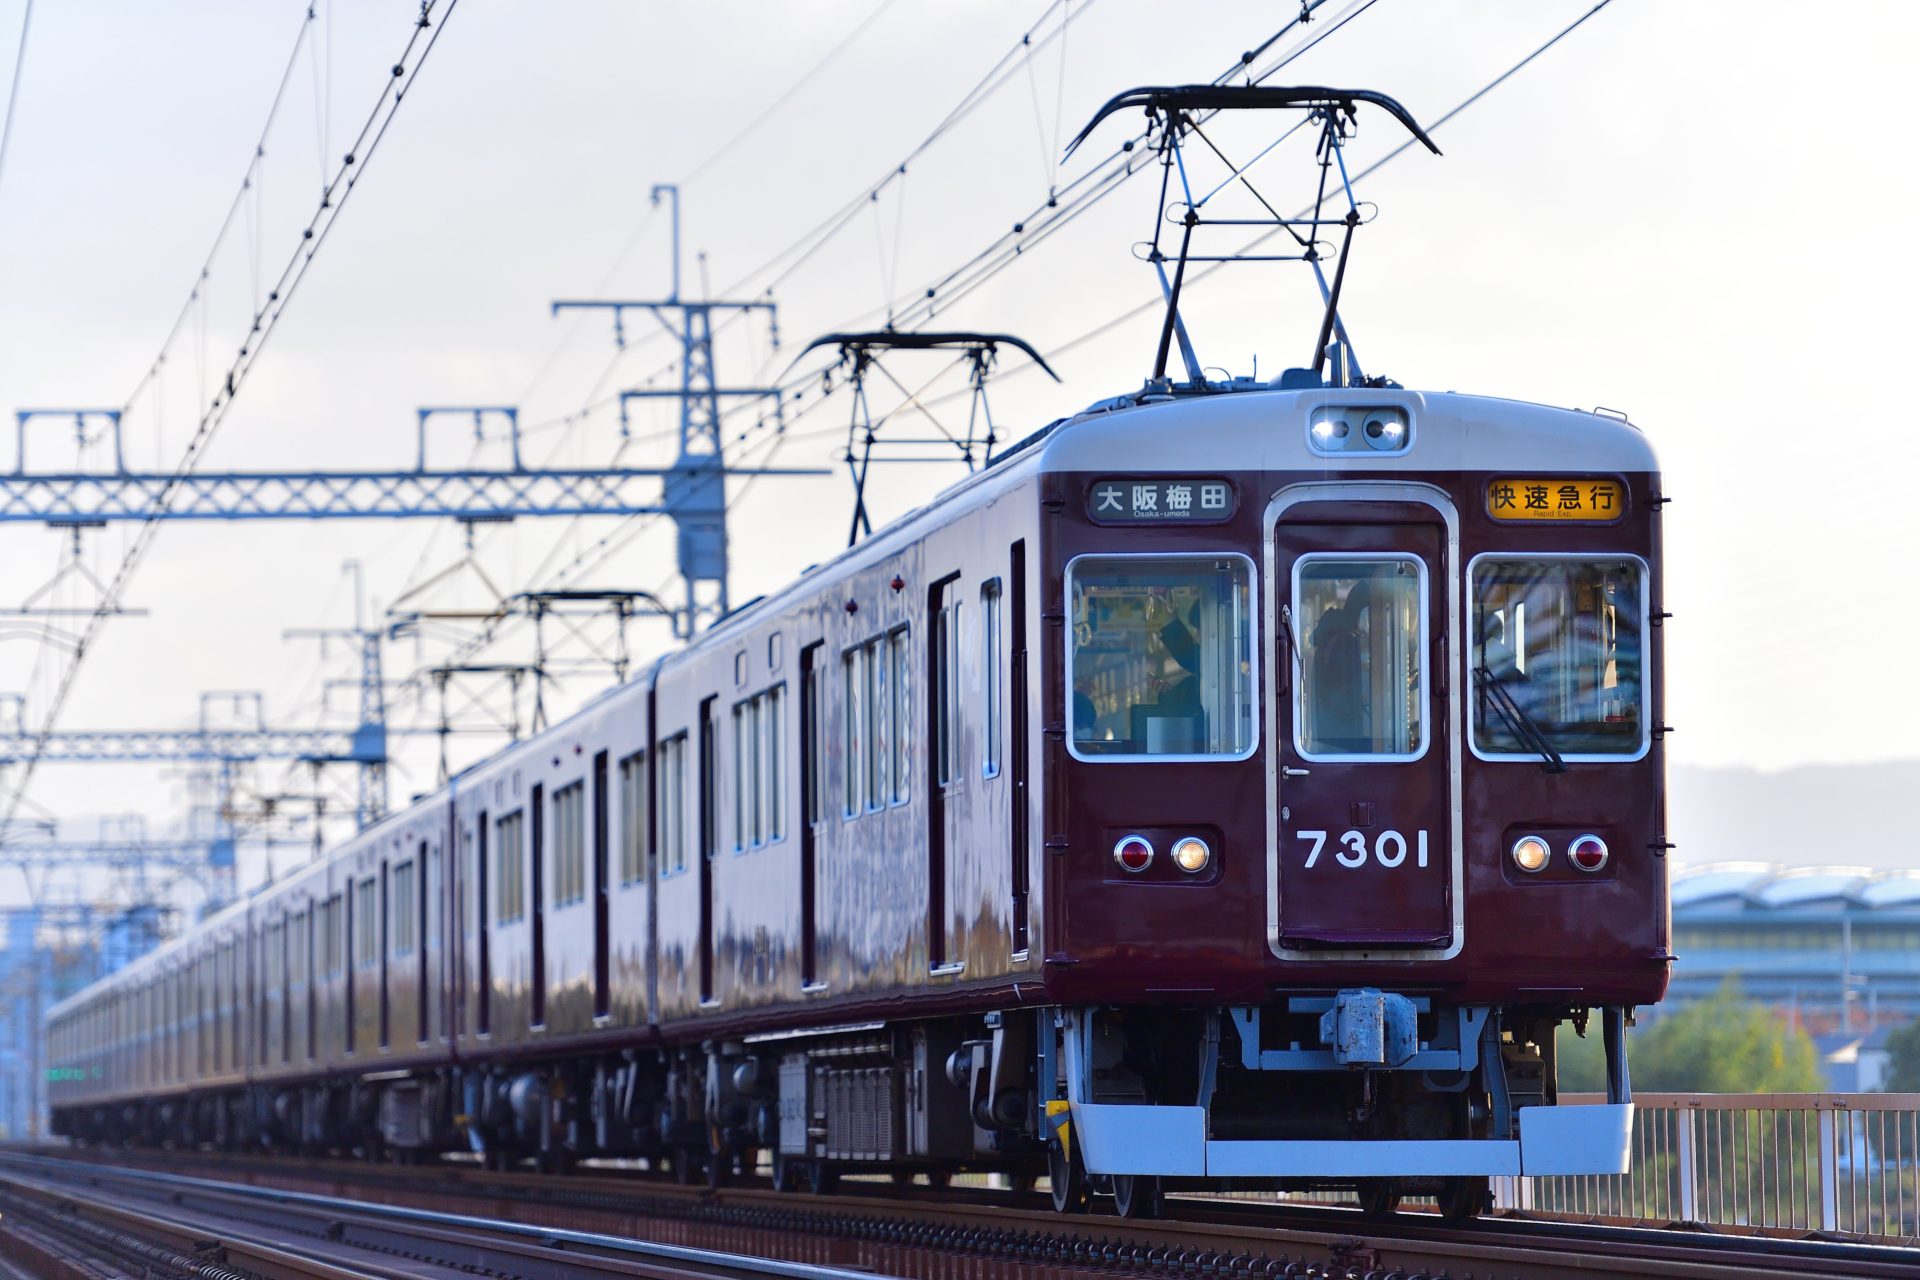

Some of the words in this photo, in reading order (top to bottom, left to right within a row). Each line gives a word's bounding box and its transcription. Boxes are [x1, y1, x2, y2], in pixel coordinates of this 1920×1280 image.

[1097, 485, 1226, 510] 大阪梅田
[1491, 485, 1614, 510] 快速急行
[1533, 510, 1555, 518] Rapid
[1296, 829, 1428, 868] 7301
